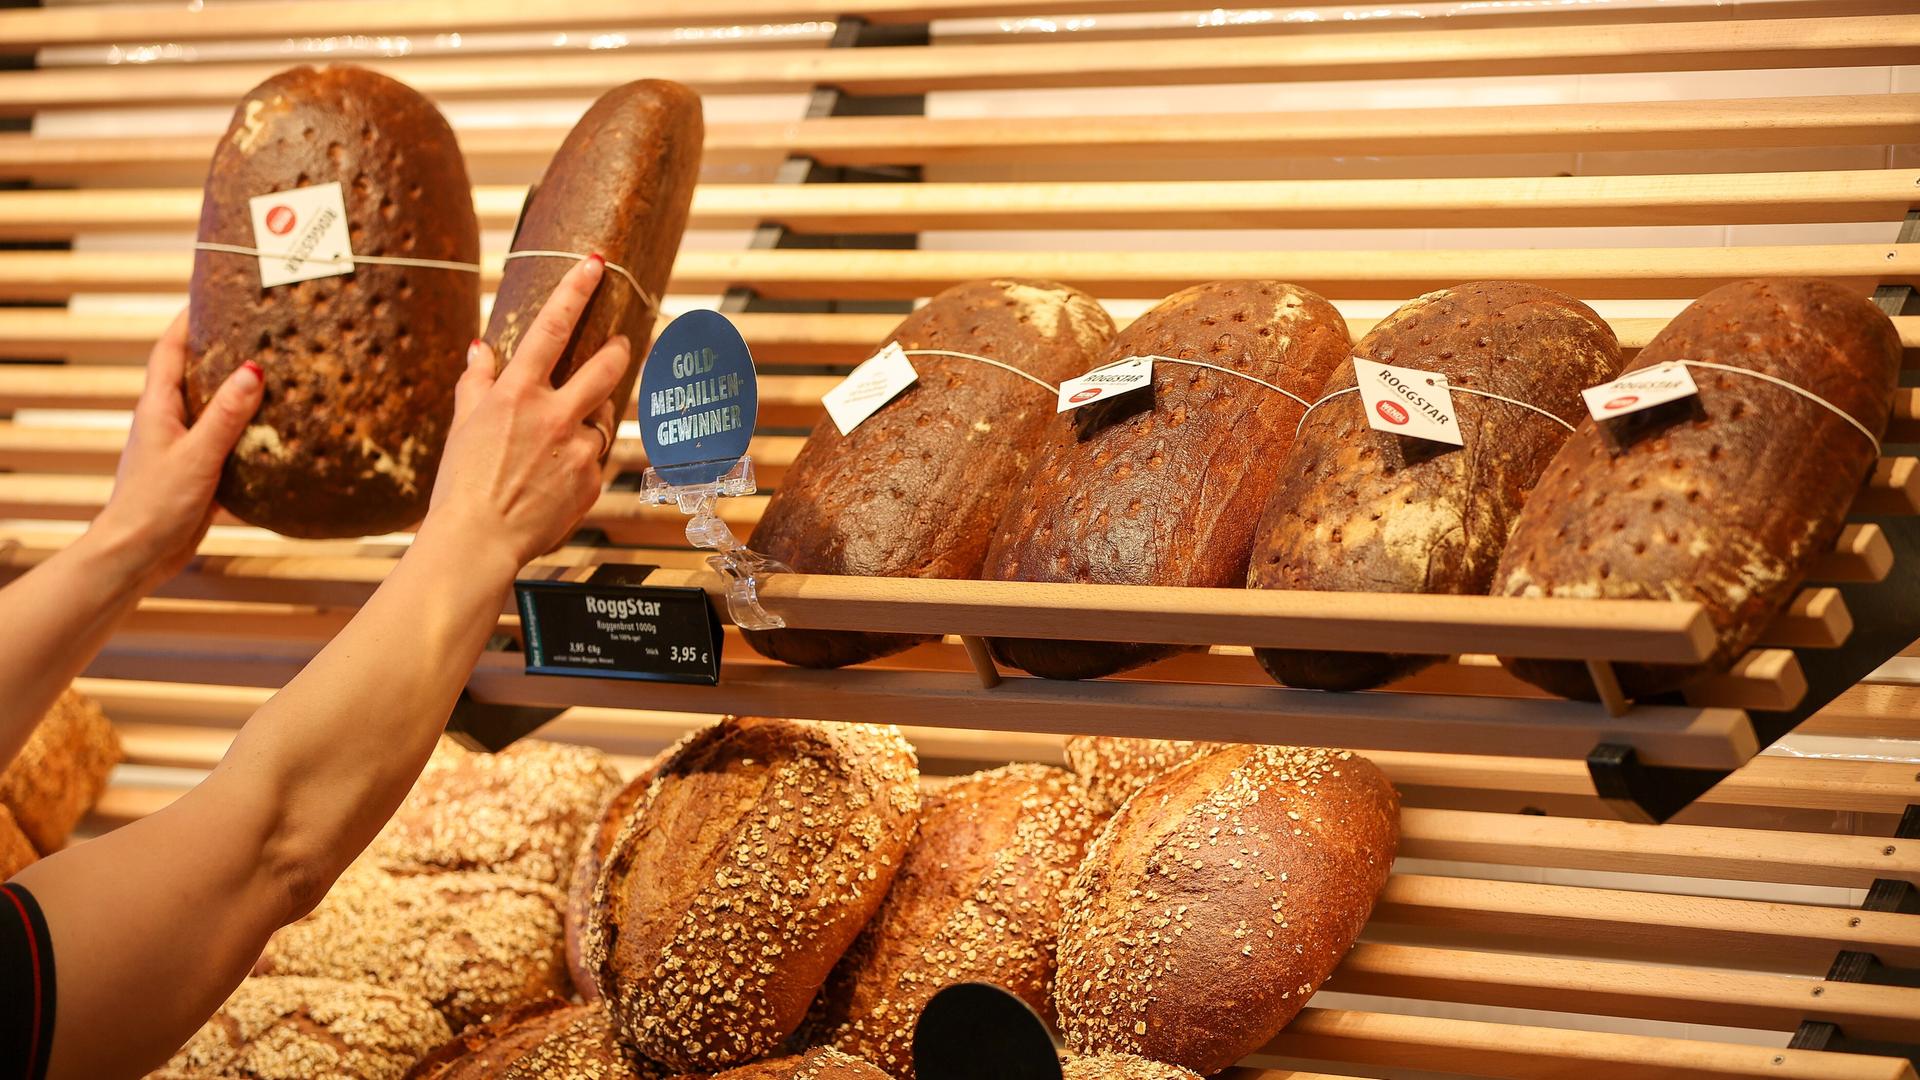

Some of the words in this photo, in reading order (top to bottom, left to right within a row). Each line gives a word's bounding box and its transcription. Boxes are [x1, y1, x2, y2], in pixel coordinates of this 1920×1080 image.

[672, 347, 718, 379] GOLD-
[650, 372, 744, 417] MEDAILLEN-
[1378, 369, 1449, 425] ROGGSTAR
[657, 404, 742, 446] GEWINNER
[586, 596, 661, 619] RoggStar
[597, 620, 634, 632] Roggenbrot
[635, 622, 656, 634] 1000g
[569, 642, 584, 654] 3,95
[670, 646, 696, 663] 3,95
[701, 653, 708, 664] €
